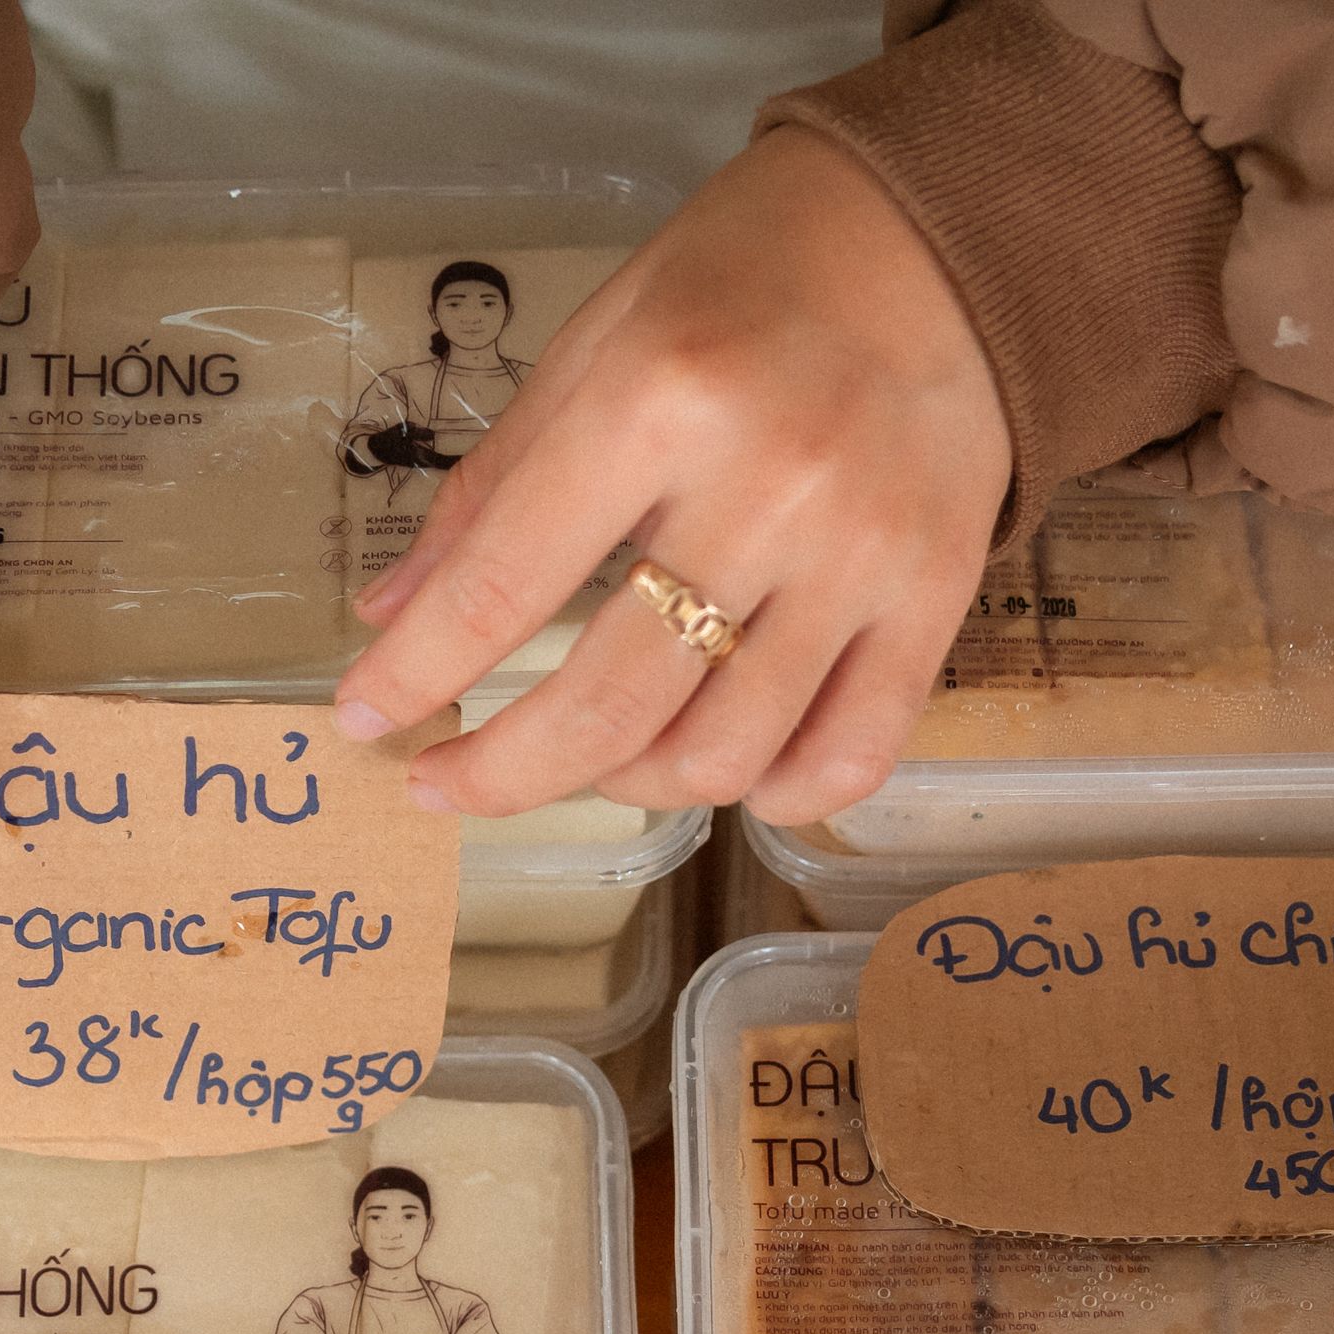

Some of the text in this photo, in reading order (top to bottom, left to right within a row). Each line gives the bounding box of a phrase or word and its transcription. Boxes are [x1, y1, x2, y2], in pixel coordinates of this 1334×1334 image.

[32, 338, 240, 399] THỐNG
[27, 409, 85, 428] GMO
[93, 408, 203, 430] Soybeans
[184, 731, 319, 826] hủ
[231, 886, 392, 978] Tofu
[917, 914, 1103, 994] Đậu
[1128, 905, 1216, 971] hủ
[751, 1137, 874, 1188] TRU
[753, 1203, 878, 1221] Tofu made
